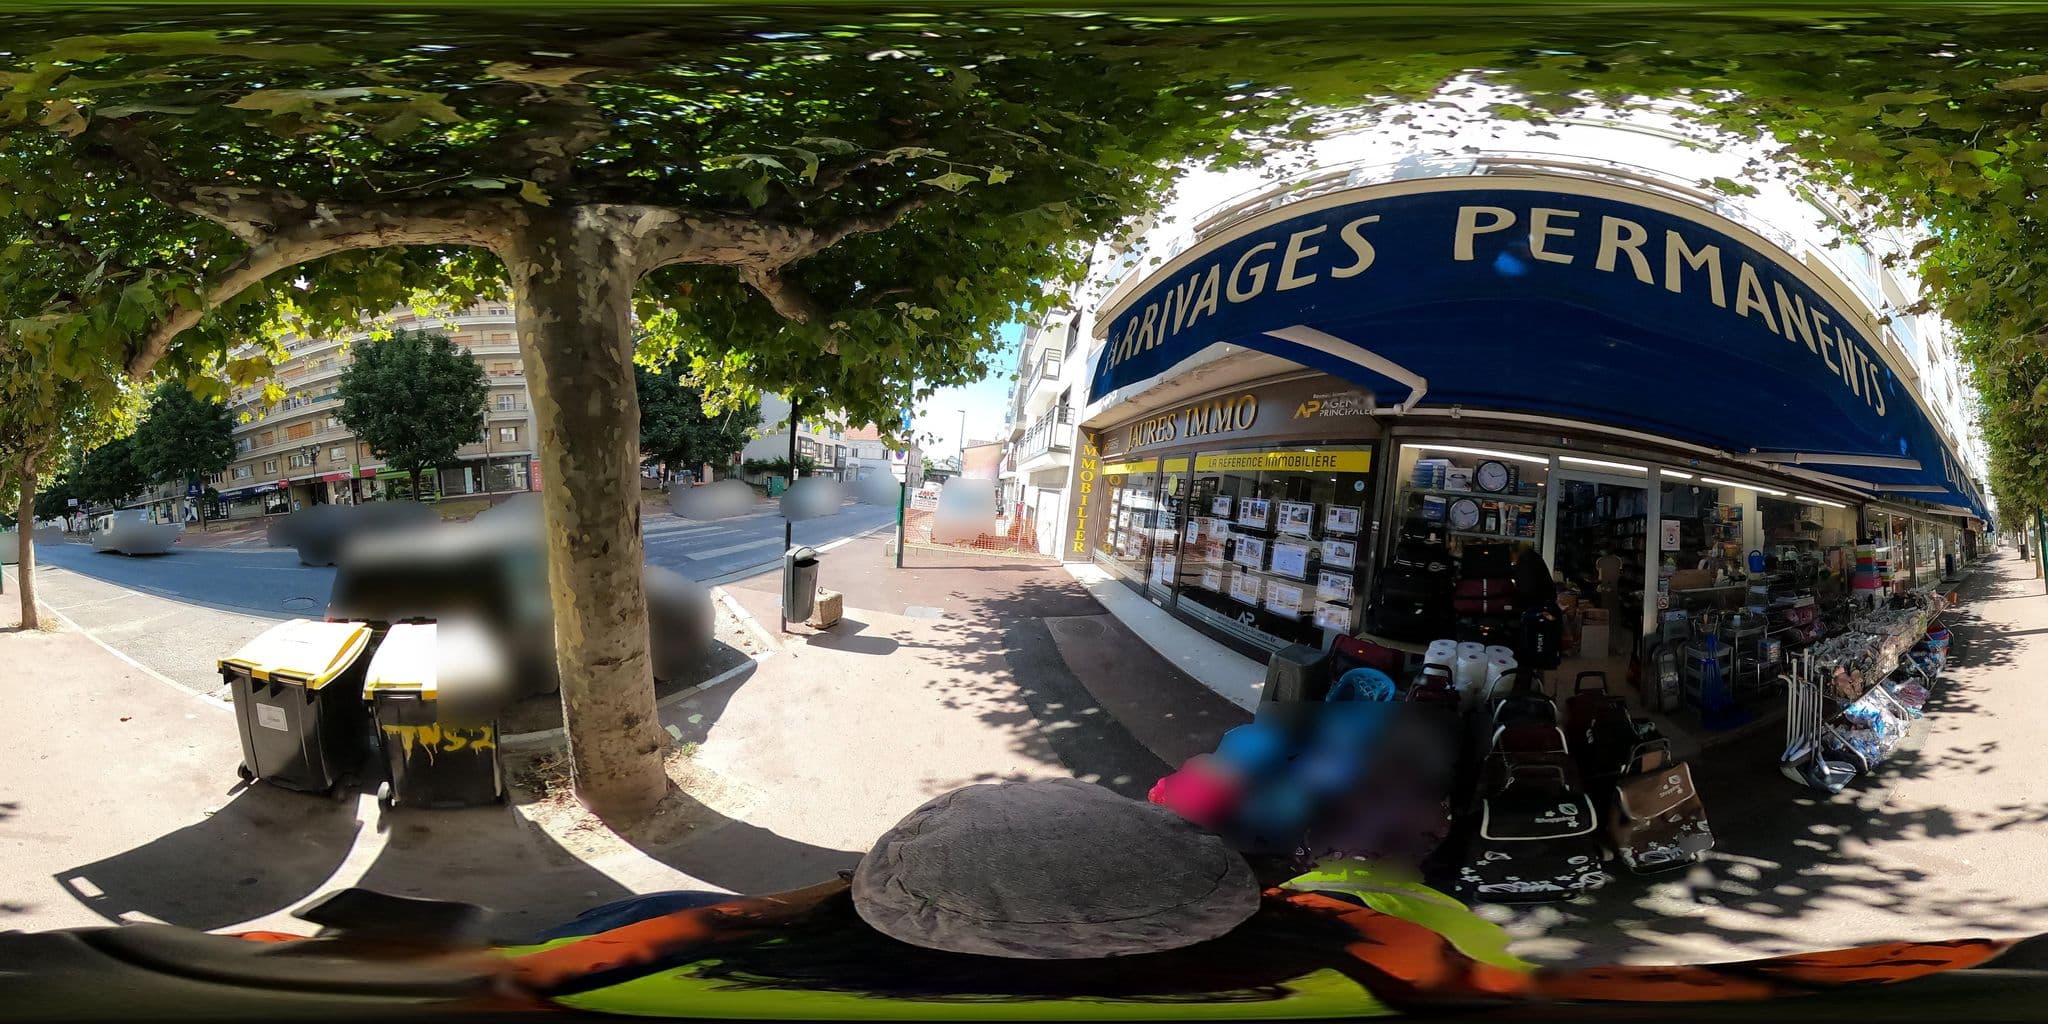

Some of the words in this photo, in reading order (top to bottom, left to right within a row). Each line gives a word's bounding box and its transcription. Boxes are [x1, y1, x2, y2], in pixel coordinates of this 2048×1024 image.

[1103, 215, 1381, 377] ARRIVAGES
[1453, 206, 1887, 417] PERMANENTS
[1183, 394, 1259, 438] IMMO
[1073, 433, 1098, 553] IMMOBILIER
